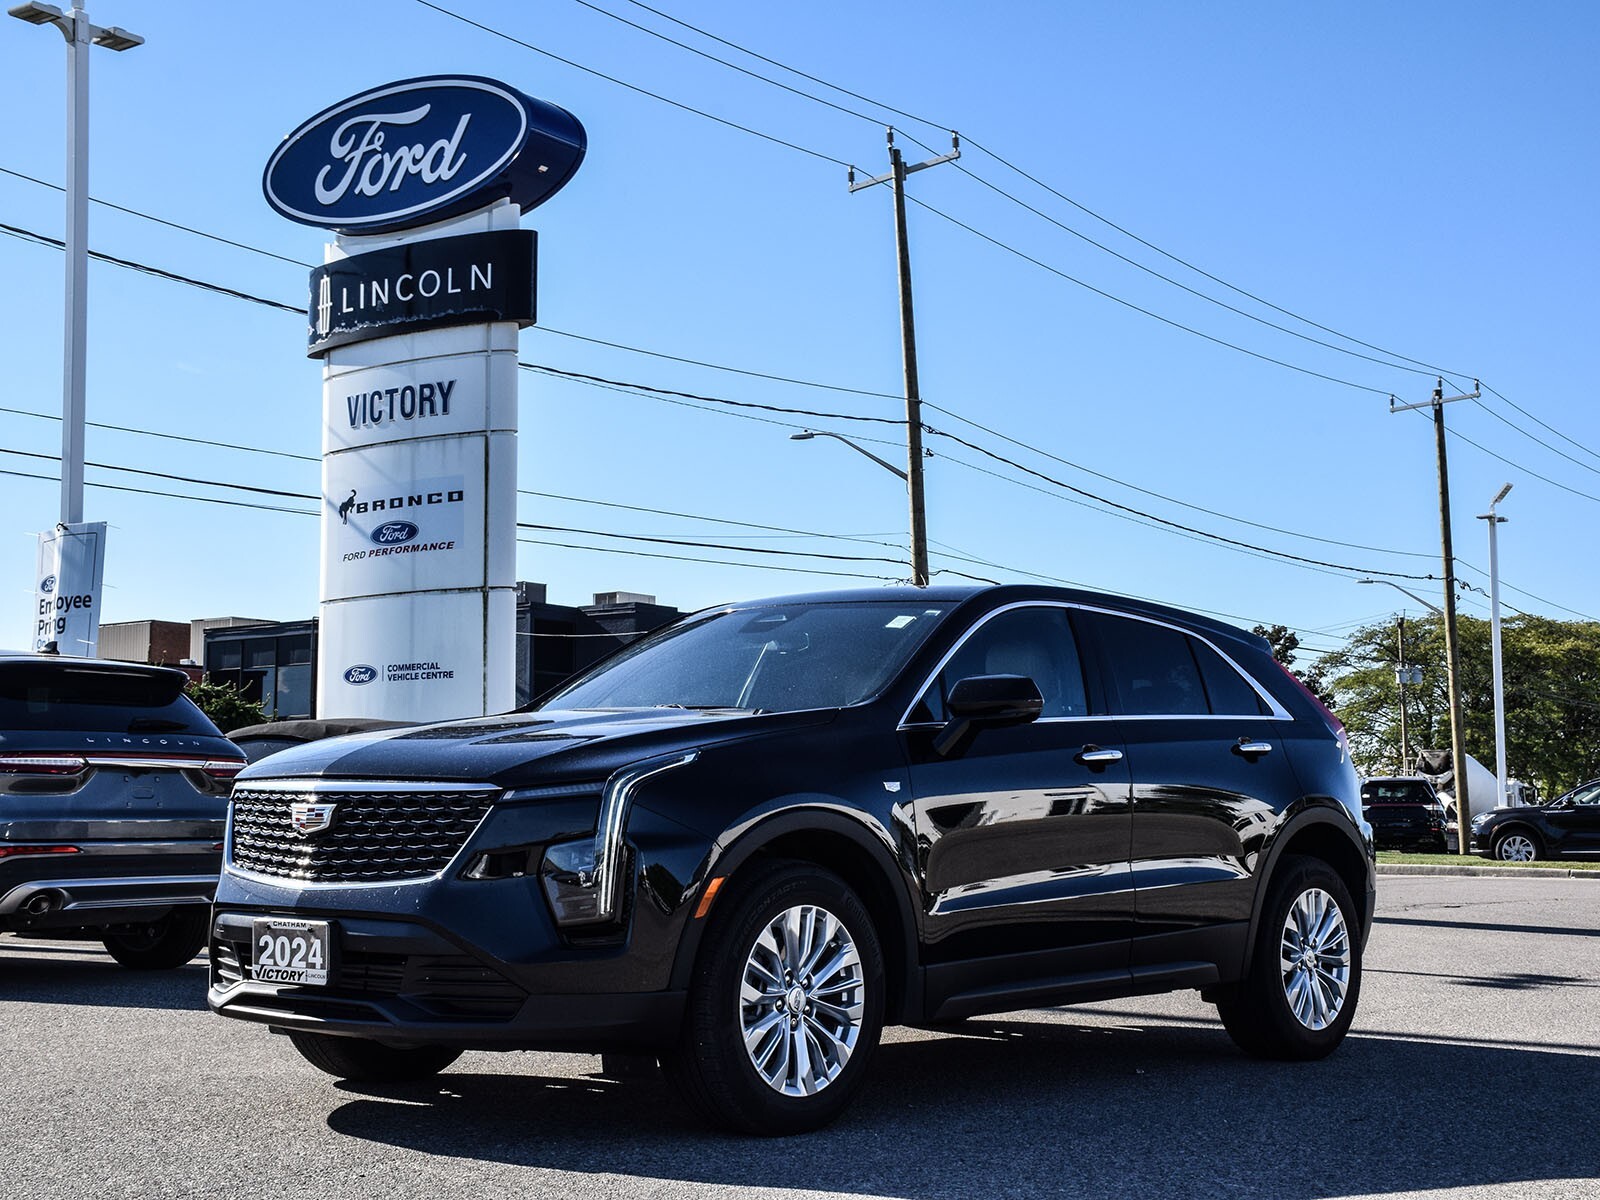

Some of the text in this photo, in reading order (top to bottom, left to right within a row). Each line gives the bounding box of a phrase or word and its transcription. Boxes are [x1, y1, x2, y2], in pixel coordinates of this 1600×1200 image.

[314, 103, 472, 206] Ford
[341, 262, 493, 315] LINCOLN
[346, 379, 457, 429] VICTORY
[356, 490, 464, 514] BRONCO
[380, 525, 409, 541] Ford
[342, 541, 455, 562] FORD PERFORMANCE
[349, 667, 371, 682] Ford
[387, 662, 441, 673] COMMERCIAL
[387, 670, 454, 682] VEHICLE CENTRE
[86, 737, 200, 746] LINCOLN
[272, 920, 307, 928] CHATHAM
[258, 934, 323, 969] 2024
[254, 964, 305, 982] VICTORY
